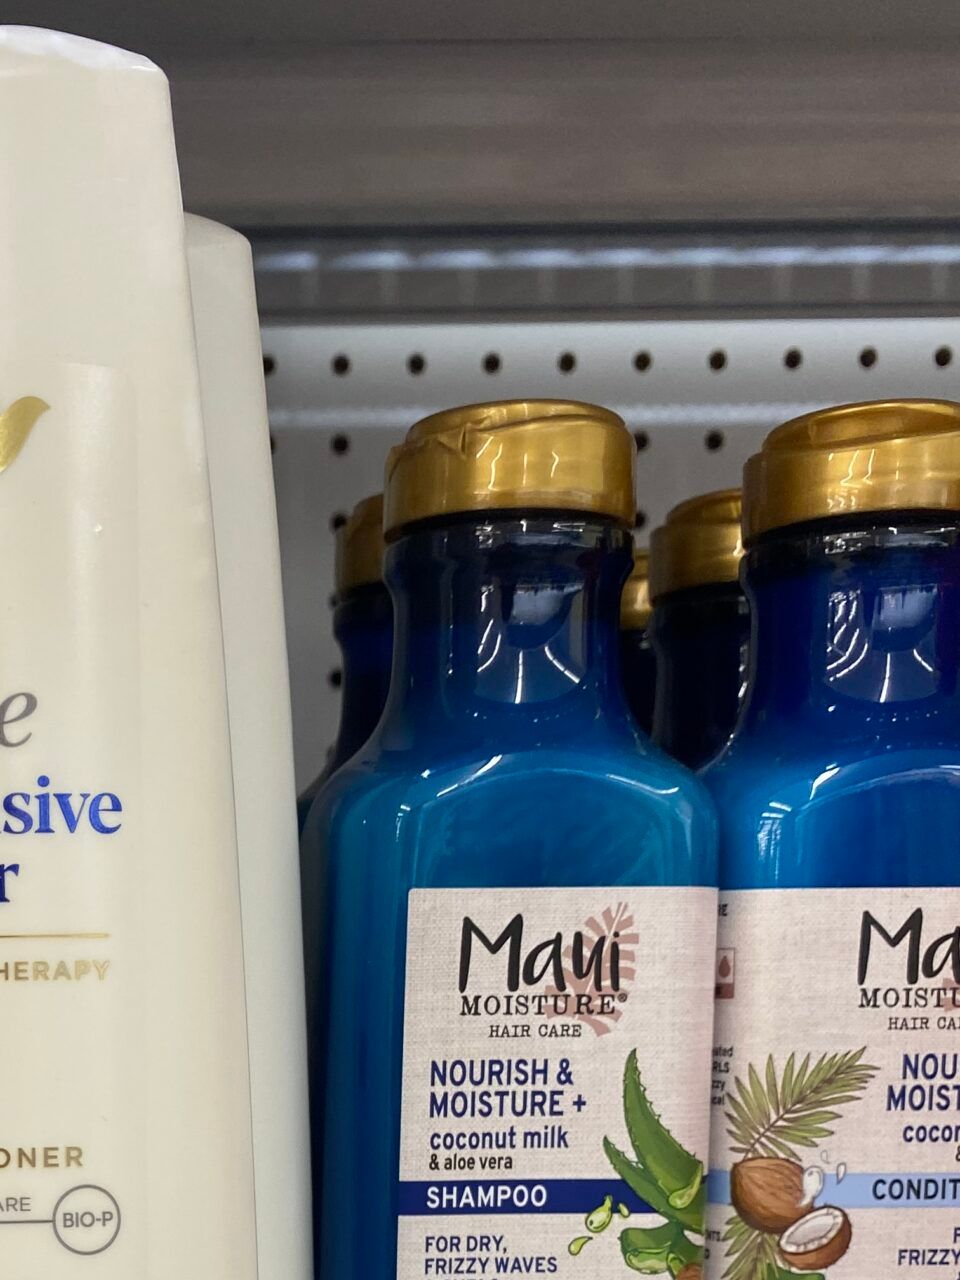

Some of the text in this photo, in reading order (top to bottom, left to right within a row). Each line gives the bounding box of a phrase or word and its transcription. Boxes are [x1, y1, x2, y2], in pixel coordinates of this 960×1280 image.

[459, 913, 620, 993] Maui
[489, 1024, 582, 1038] HAIR CARE
[888, 1017, 929, 1030] HAIR
[430, 1058, 573, 1086] NOURISH &
[429, 1090, 564, 1118] MOISTURE
[430, 1126, 568, 1151] coconut milk
[429, 1154, 512, 1170] & aloe vera
[426, 1185, 547, 1208] SHAMPOO
[63, 1211, 113, 1228] BIO-P
[425, 1235, 507, 1253] FOR DRY,
[424, 1257, 557, 1275] FRIZZY WAVES
